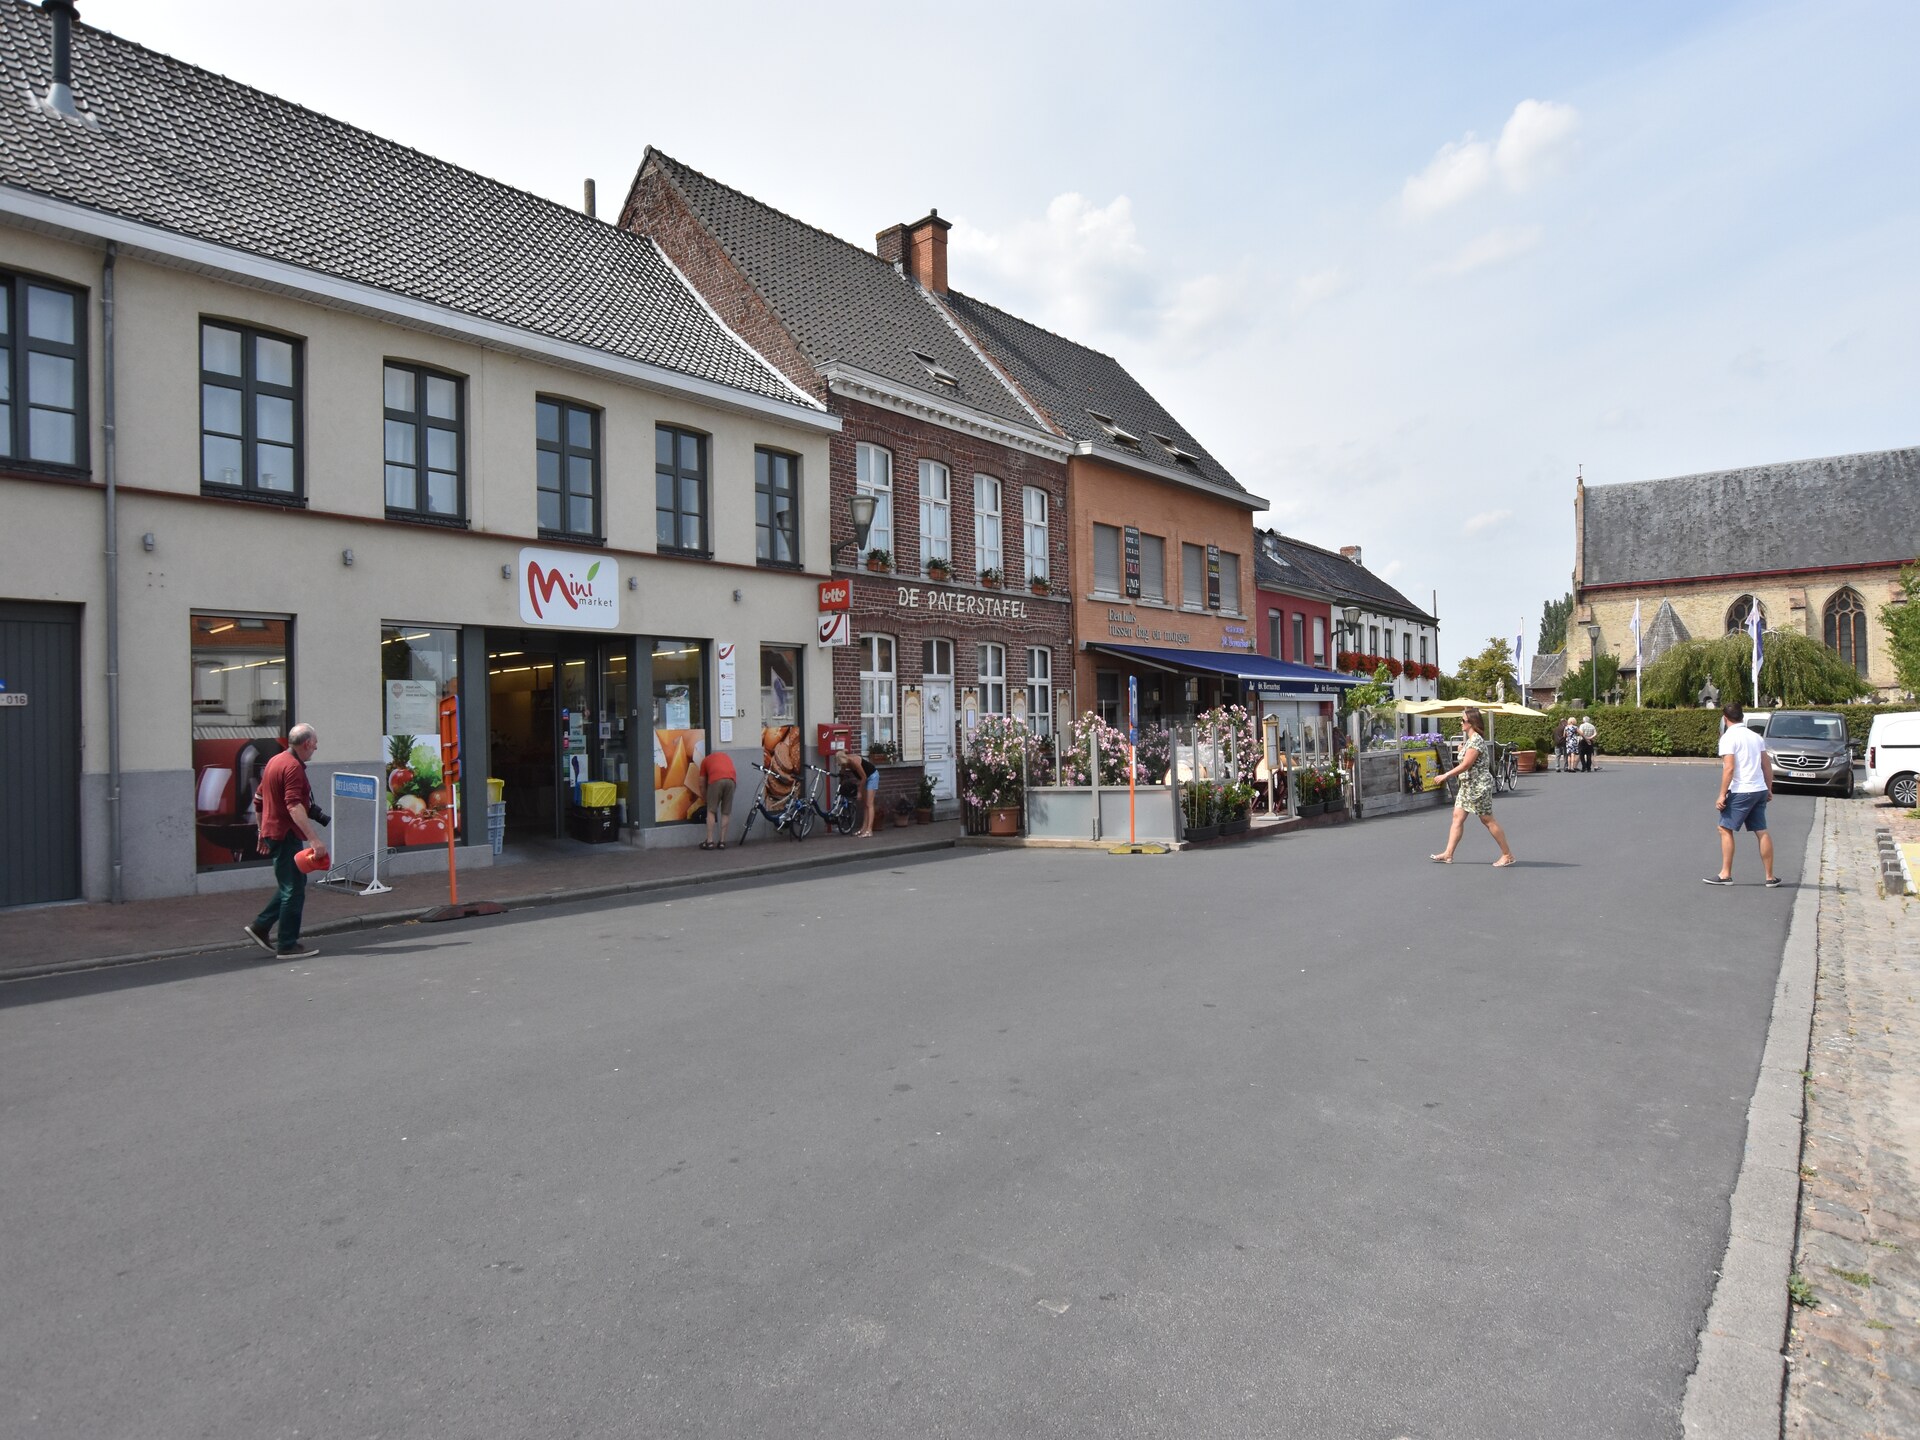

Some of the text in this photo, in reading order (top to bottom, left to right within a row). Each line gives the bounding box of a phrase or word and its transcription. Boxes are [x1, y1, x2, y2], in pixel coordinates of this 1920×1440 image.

[528, 560, 593, 619] Mini
[822, 588, 846, 604] Lotto
[578, 598, 612, 607] market
[898, 586, 1028, 618] DE PATERSTAFEL
[1108, 608, 1136, 624] Een huis
[1109, 624, 1191, 646] tussen dag en morgen
[738, 709, 746, 718] 13
